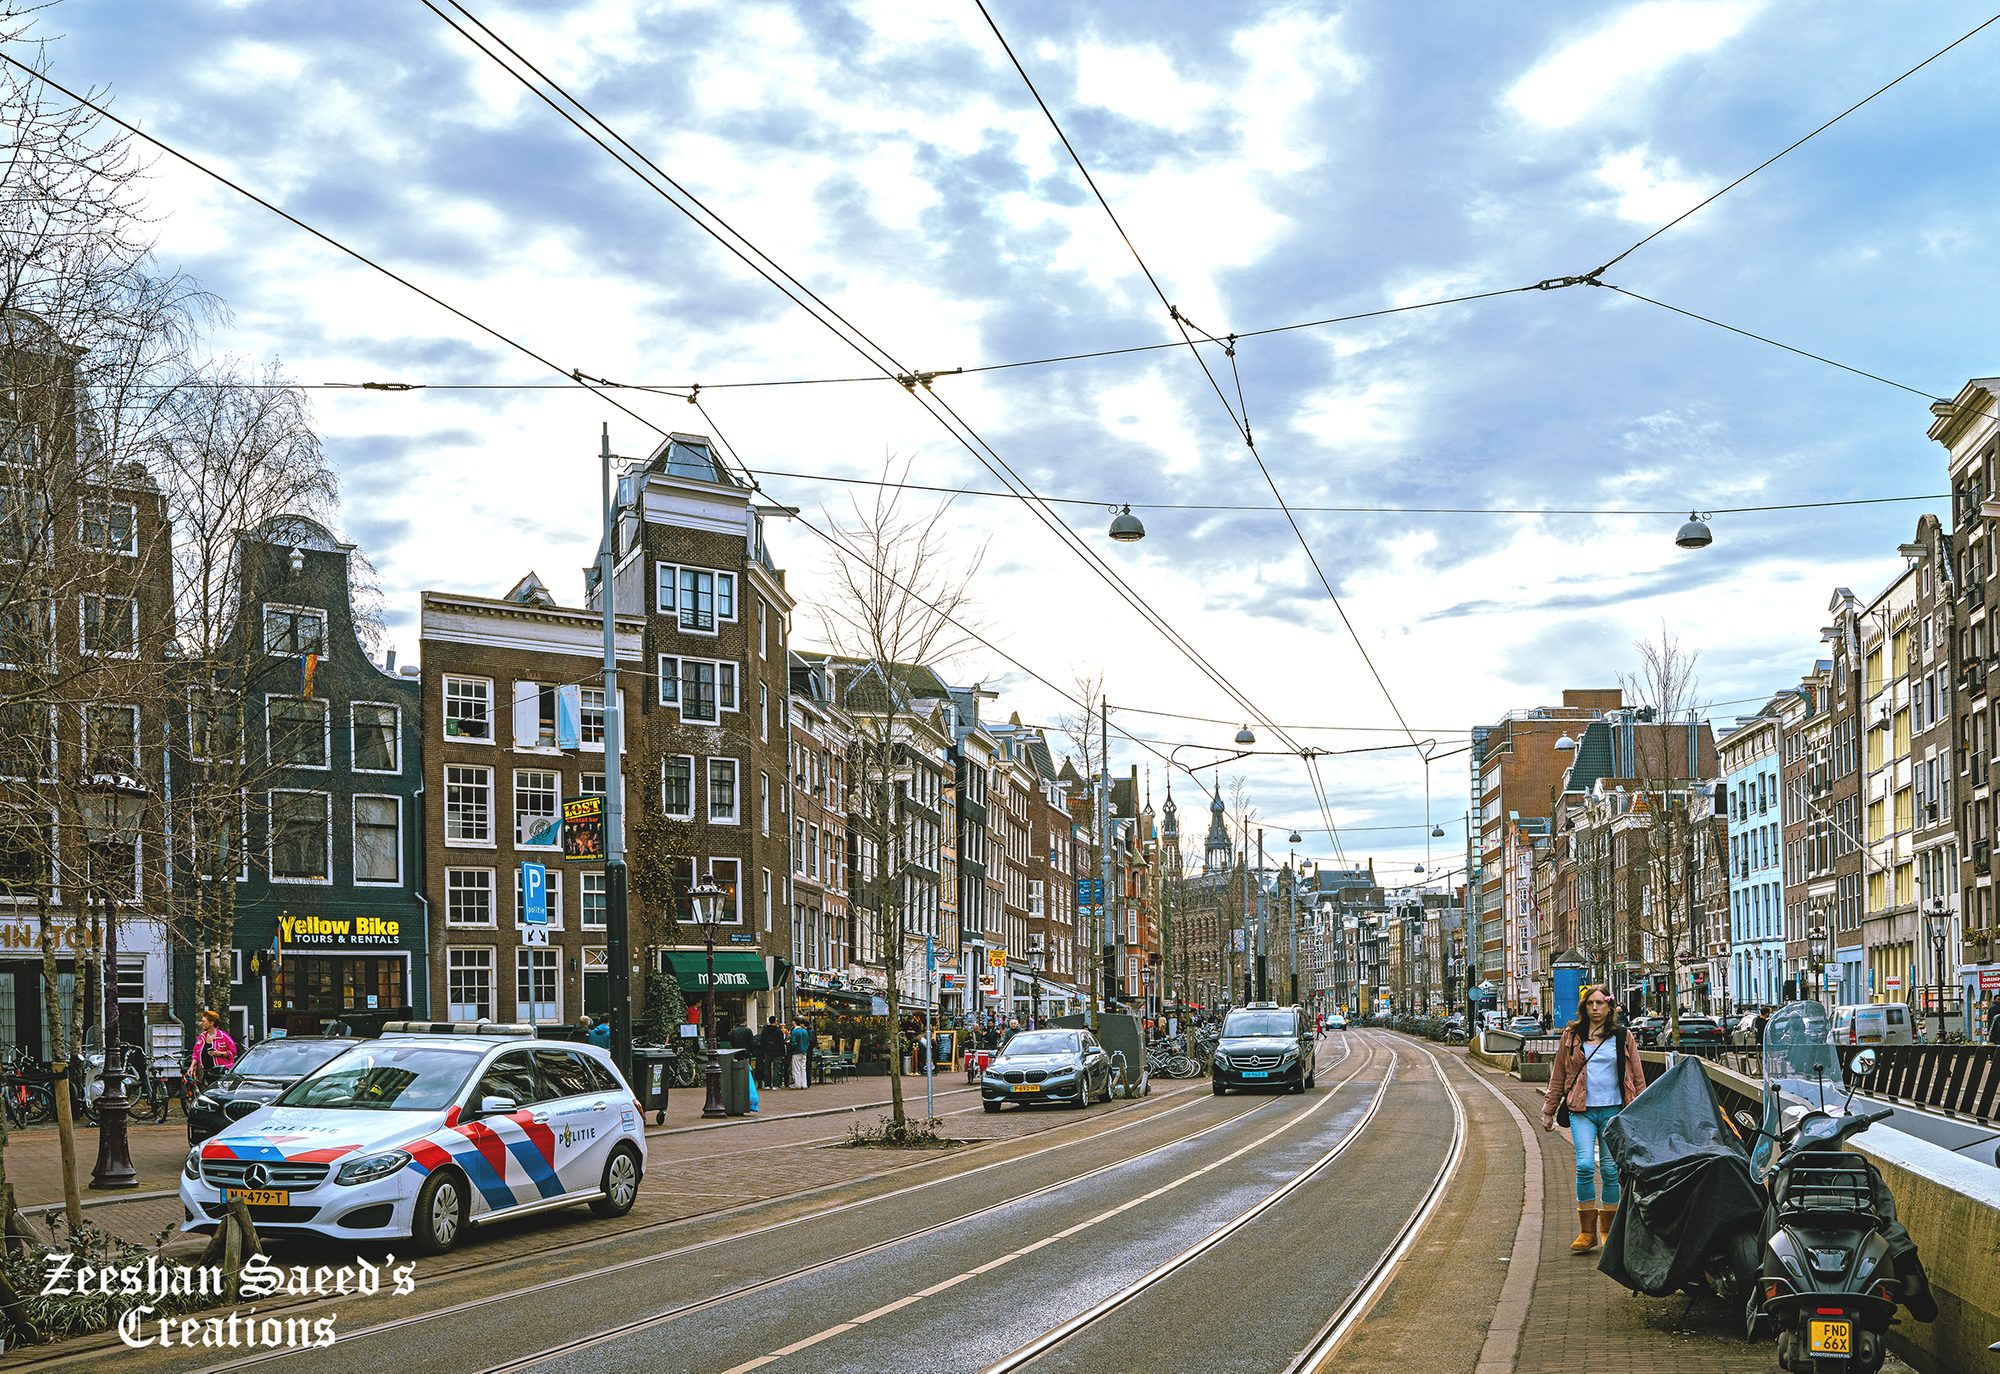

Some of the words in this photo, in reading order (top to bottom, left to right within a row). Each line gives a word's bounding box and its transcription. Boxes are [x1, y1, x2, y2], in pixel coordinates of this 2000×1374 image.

[564, 801, 600, 817] LOST
[529, 868, 541, 898] P
[278, 916, 350, 943] Yellow
[356, 917, 399, 935] Bike
[295, 935, 333, 943] TOURS
[351, 936, 400, 944] RENTALS
[698, 973, 749, 985] MORTIMER
[261, 1126, 340, 1134] POLITIE
[559, 1127, 596, 1148] POLITIE
[1824, 1325, 1847, 1336] FND
[1824, 1337, 1847, 1350] 66X
